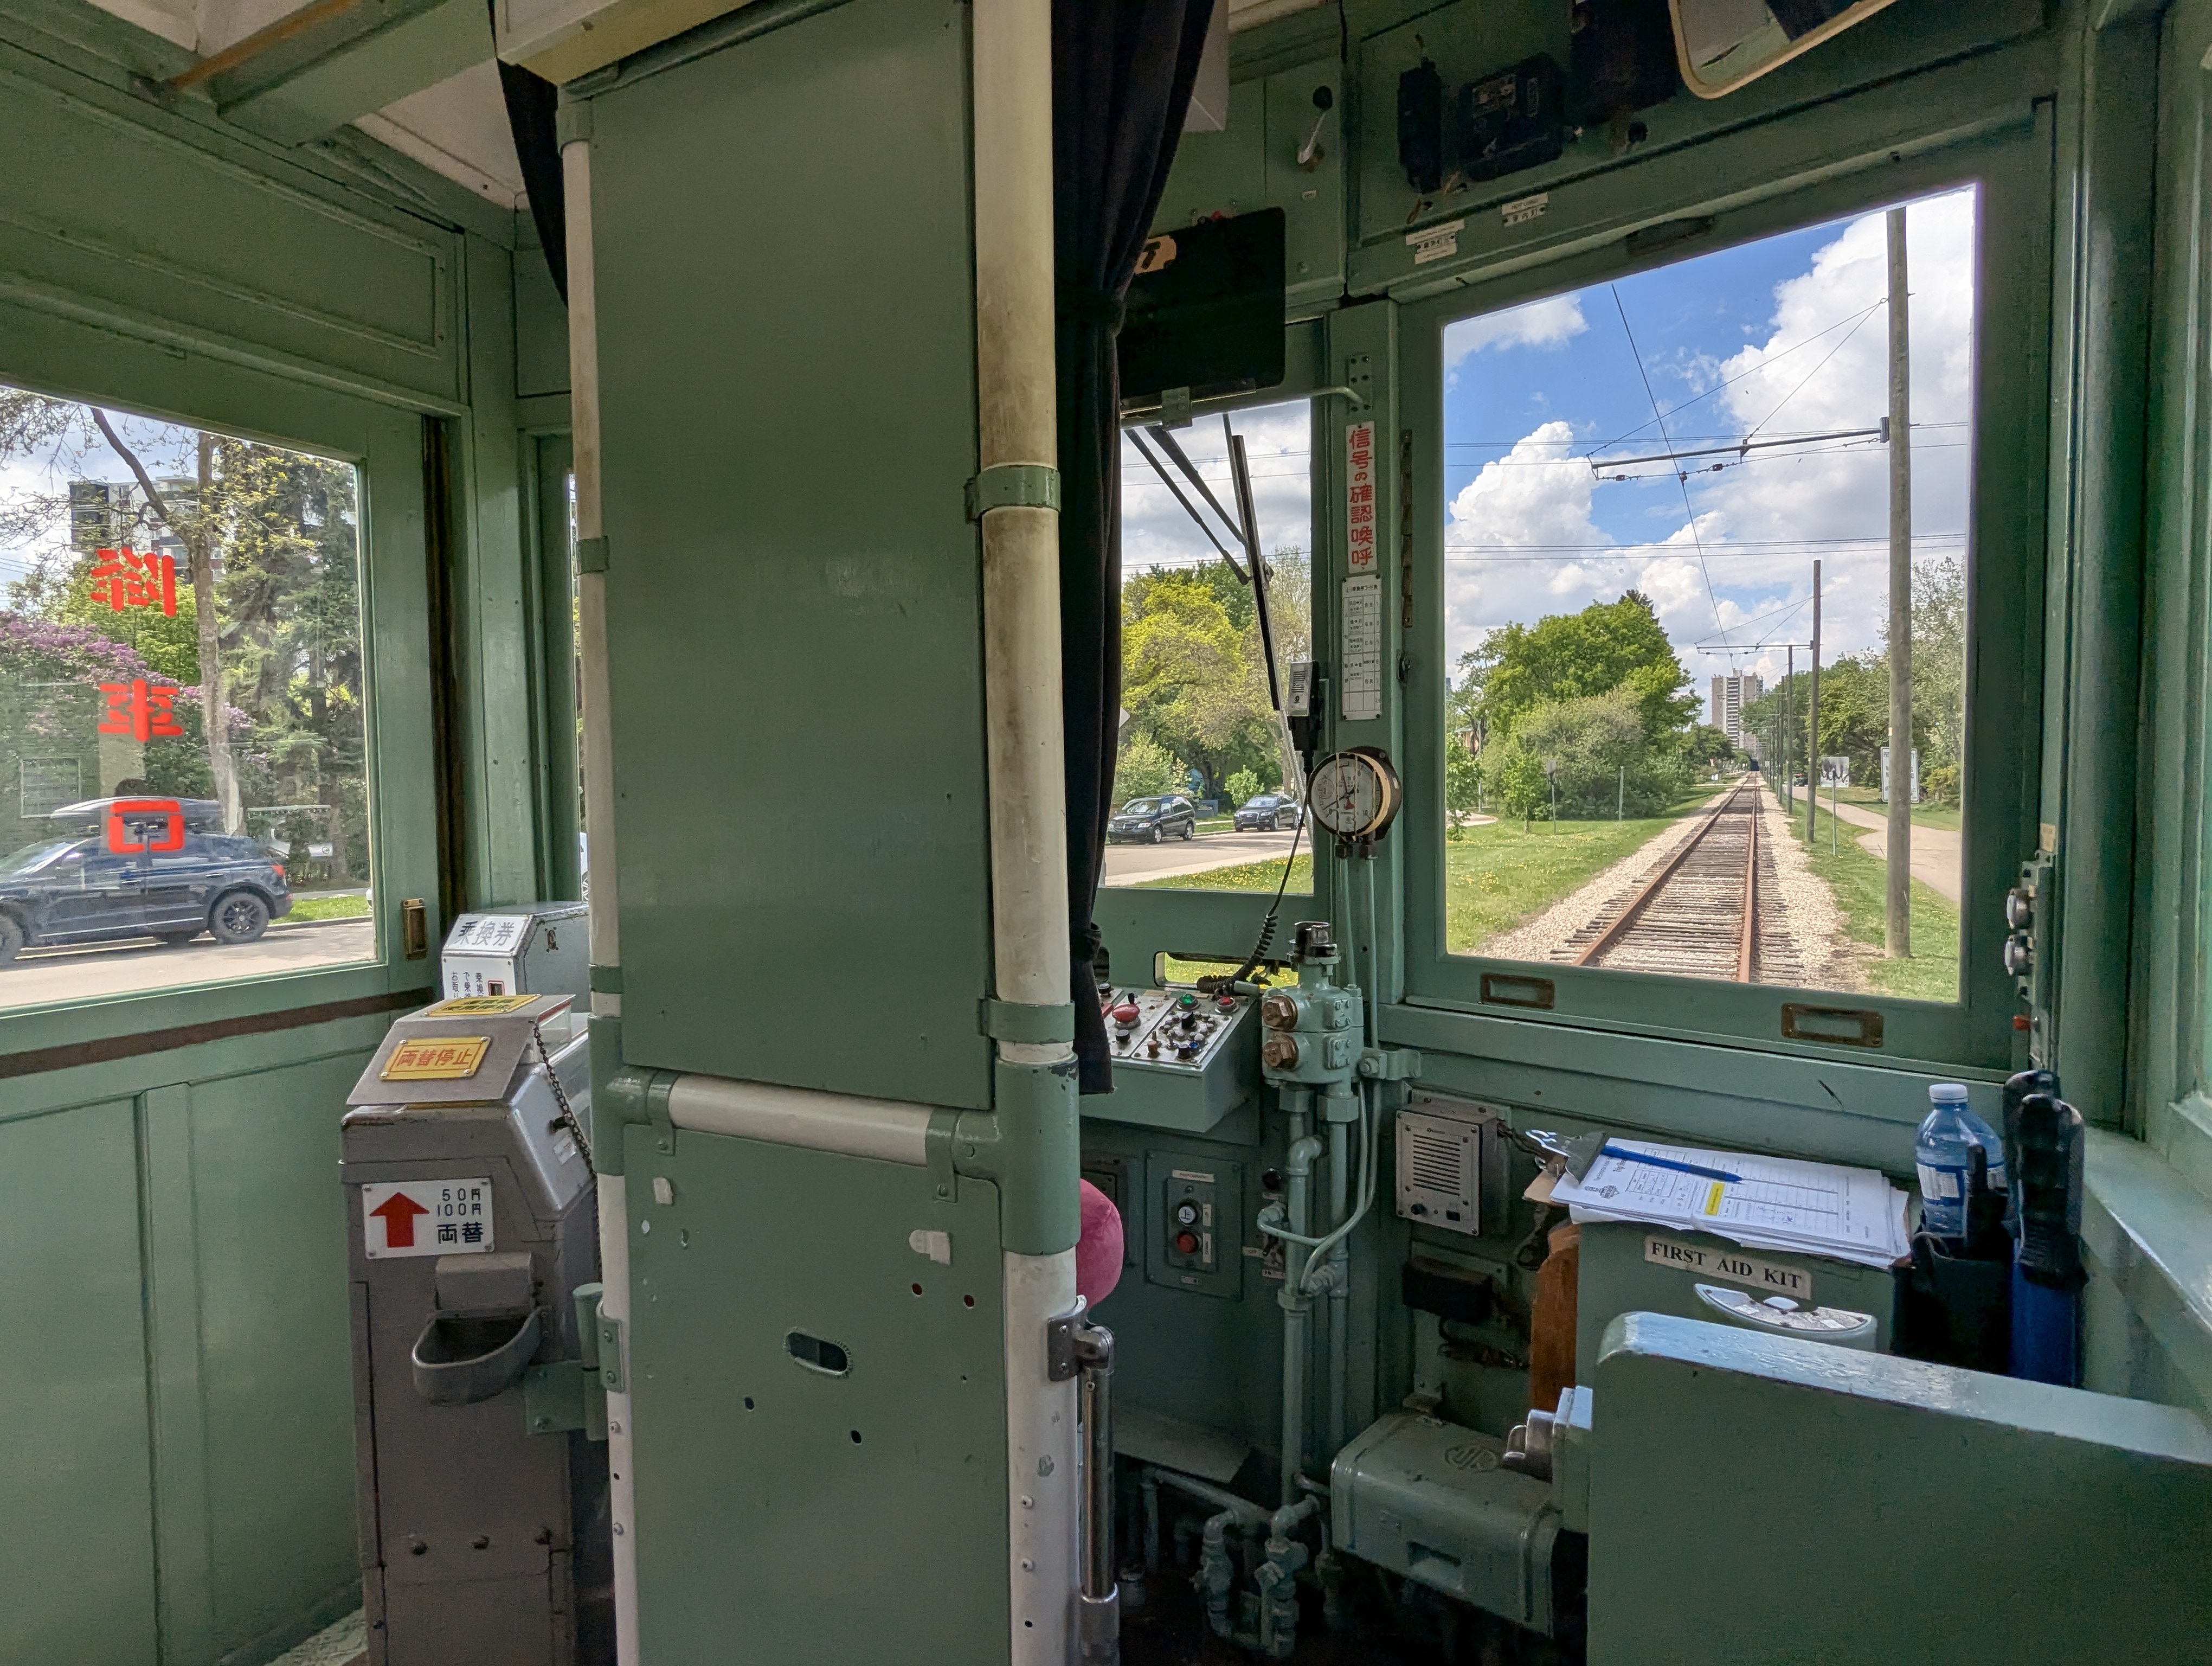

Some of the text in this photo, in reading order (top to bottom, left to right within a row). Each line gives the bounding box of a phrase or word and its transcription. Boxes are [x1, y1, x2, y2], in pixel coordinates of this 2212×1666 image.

[1349, 428, 1373, 565] 信号の確認喚呼
[454, 920, 515, 946] 乗換券
[396, 1048, 473, 1066] 両替停止
[436, 1221, 484, 1244] 両替
[1651, 1241, 1802, 1289] FIRST AID KIT
